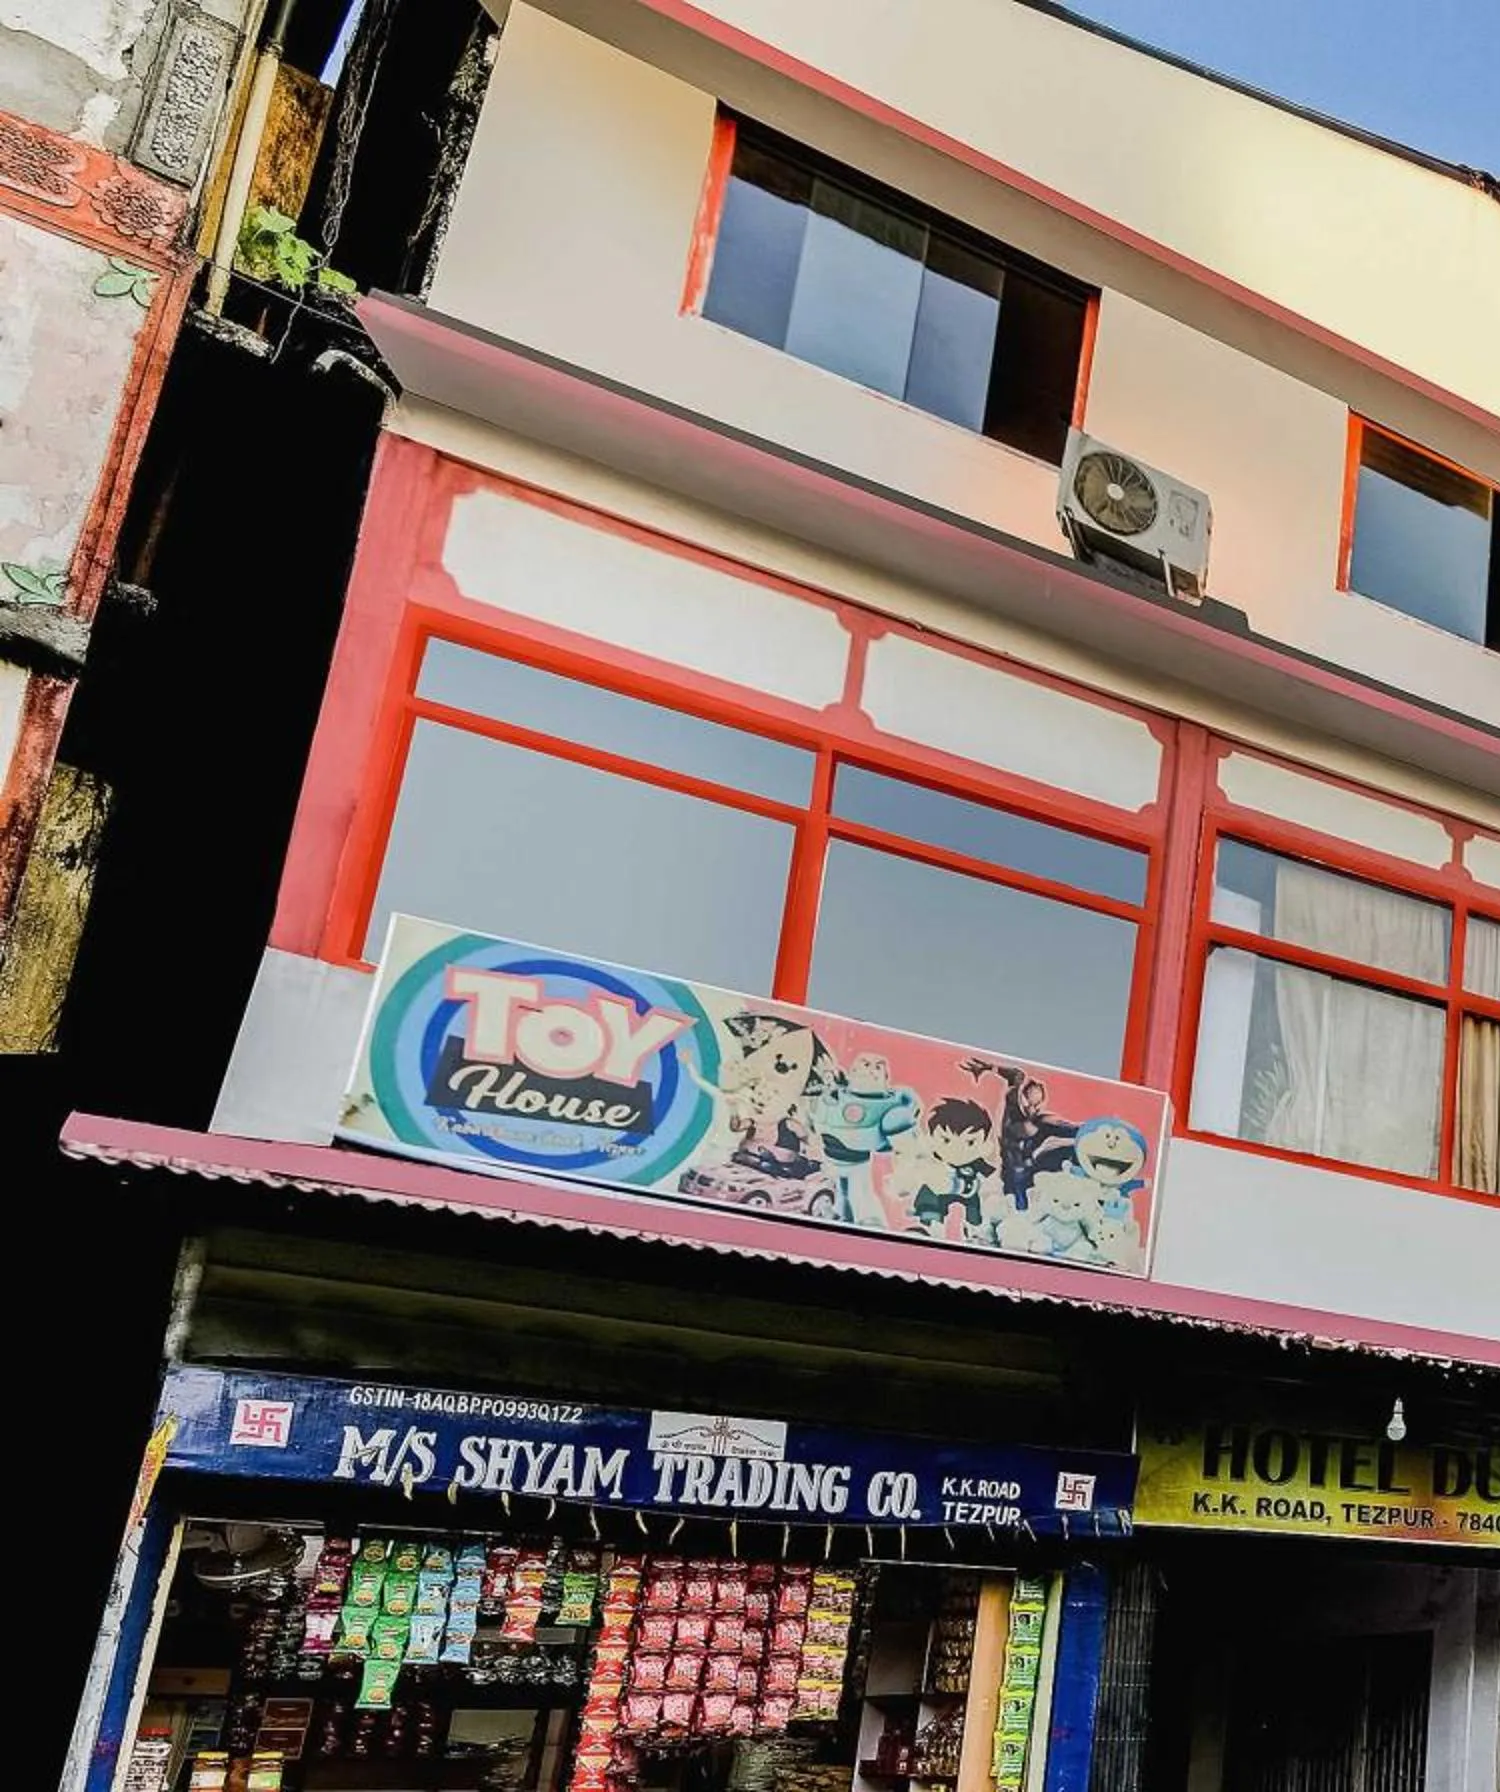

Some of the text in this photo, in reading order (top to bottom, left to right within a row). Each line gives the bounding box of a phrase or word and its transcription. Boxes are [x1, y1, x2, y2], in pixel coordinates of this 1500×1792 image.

[444, 964, 698, 1088] TOY
[448, 1065, 640, 1127] House
[332, 1425, 921, 1521] M/S SHYAM TRADING CO.
[1203, 1422, 1412, 1496] HOTEL
[1192, 1490, 1247, 1516] K.K.
[1255, 1496, 1331, 1526] ROAD,
[1342, 1503, 1435, 1527] TEZPUR
